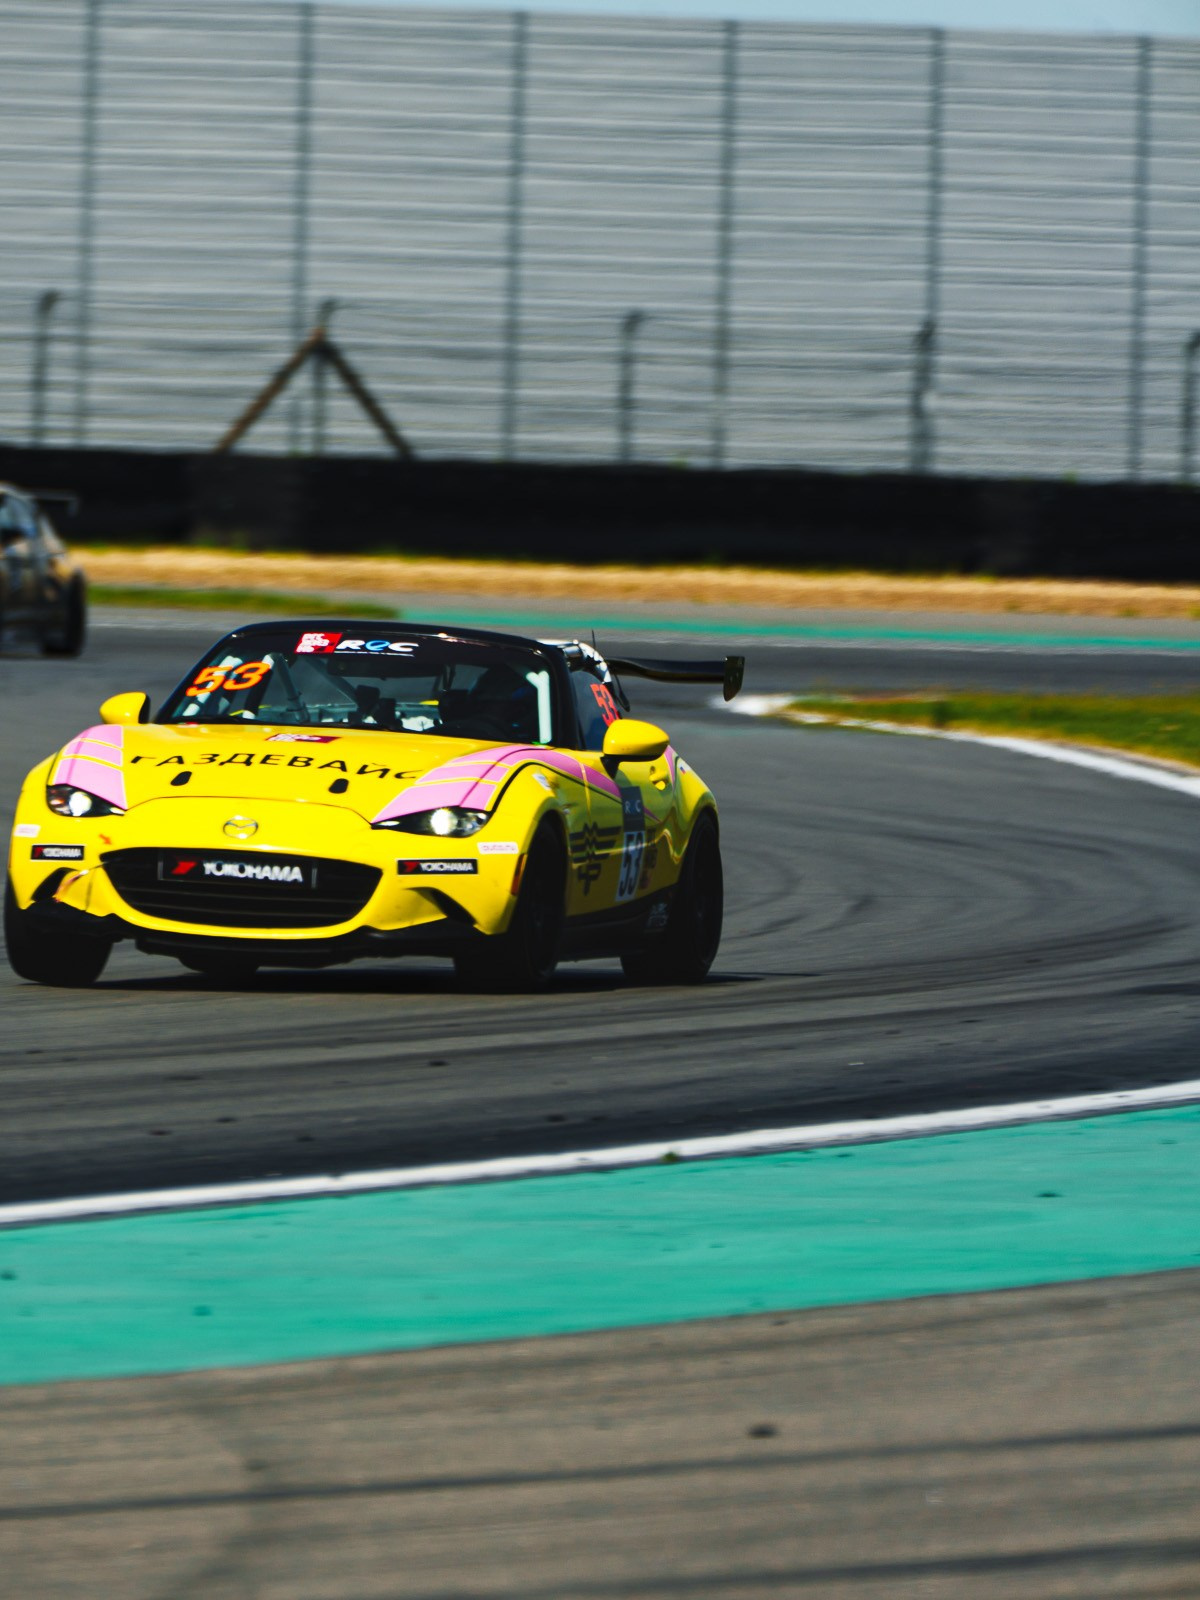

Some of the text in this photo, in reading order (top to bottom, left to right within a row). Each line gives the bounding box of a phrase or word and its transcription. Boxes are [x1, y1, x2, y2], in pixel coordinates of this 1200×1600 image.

[185, 661, 270, 697] 53
[590, 683, 621, 728] 53
[130, 752, 422, 780] ГАЗДЕВАЙС
[203, 860, 303, 882] YOKOHAMA
[420, 861, 474, 872] YOKOHAMA
[618, 831, 644, 897] 53
